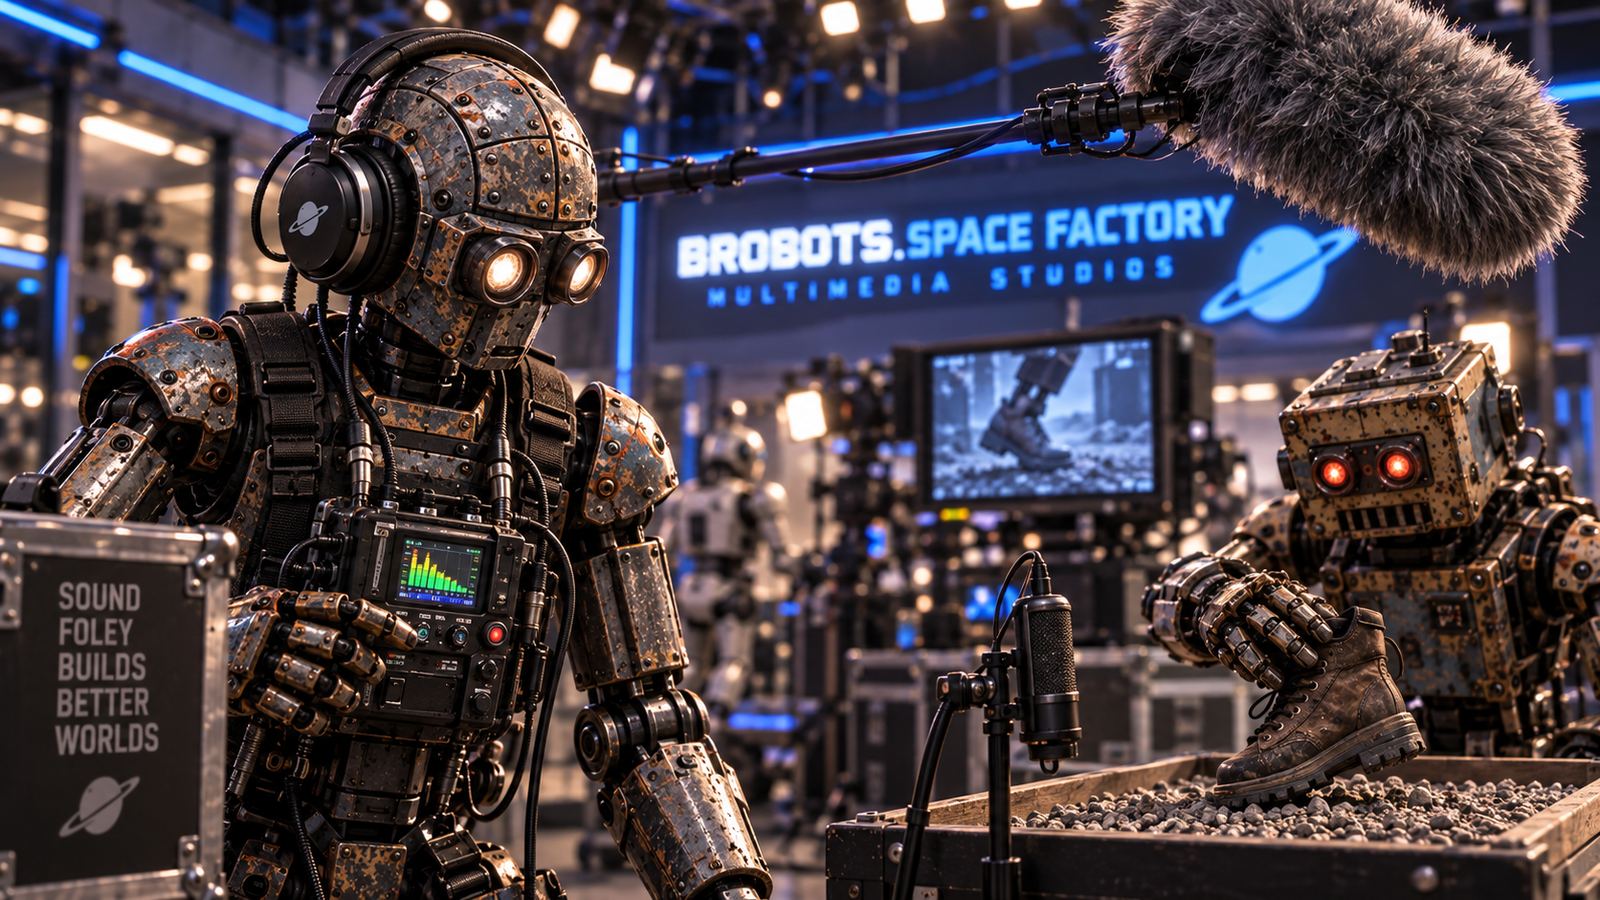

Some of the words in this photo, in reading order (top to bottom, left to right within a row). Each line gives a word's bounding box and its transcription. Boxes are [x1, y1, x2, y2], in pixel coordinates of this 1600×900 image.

[1045, 194, 1235, 251] FACTORY
[706, 269, 950, 309] MULTIMEDIA
[989, 254, 1175, 291] STUDIOS
[58, 581, 141, 612] SOUND
[58, 617, 134, 647] FOLEY
[58, 652, 146, 682] BUILDS
[56, 687, 149, 718] BETTER
[54, 722, 159, 756] WORLDS
